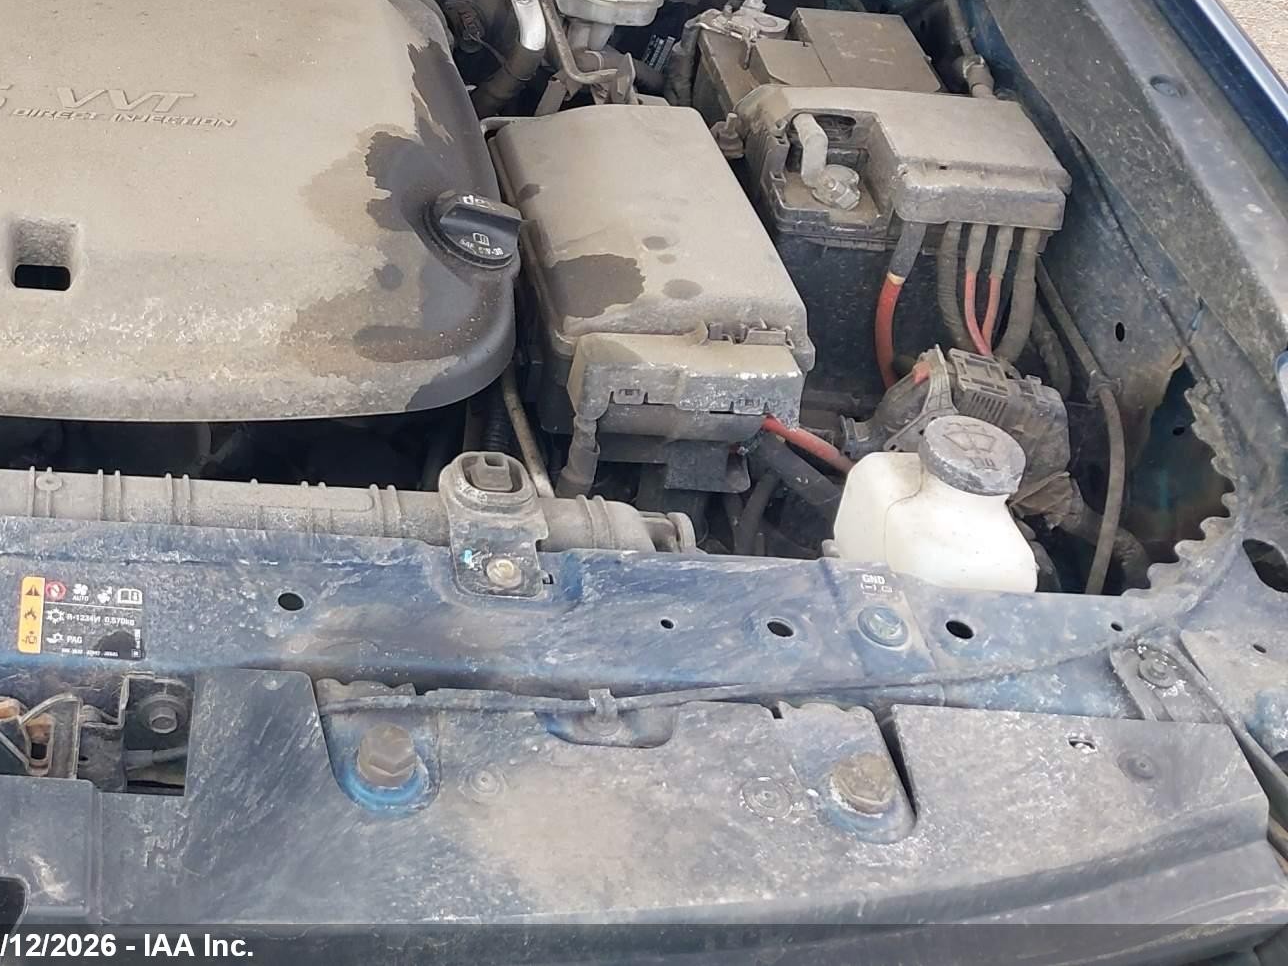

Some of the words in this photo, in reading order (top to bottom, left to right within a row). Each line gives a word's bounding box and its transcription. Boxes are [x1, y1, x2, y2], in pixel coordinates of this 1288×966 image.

[56, 87, 197, 112] VVT
[12, 107, 104, 121] DIRECT
[112, 113, 237, 128] INJECTION
[862, 574, 886, 585] GND
[66, 635, 83, 644] PAG
